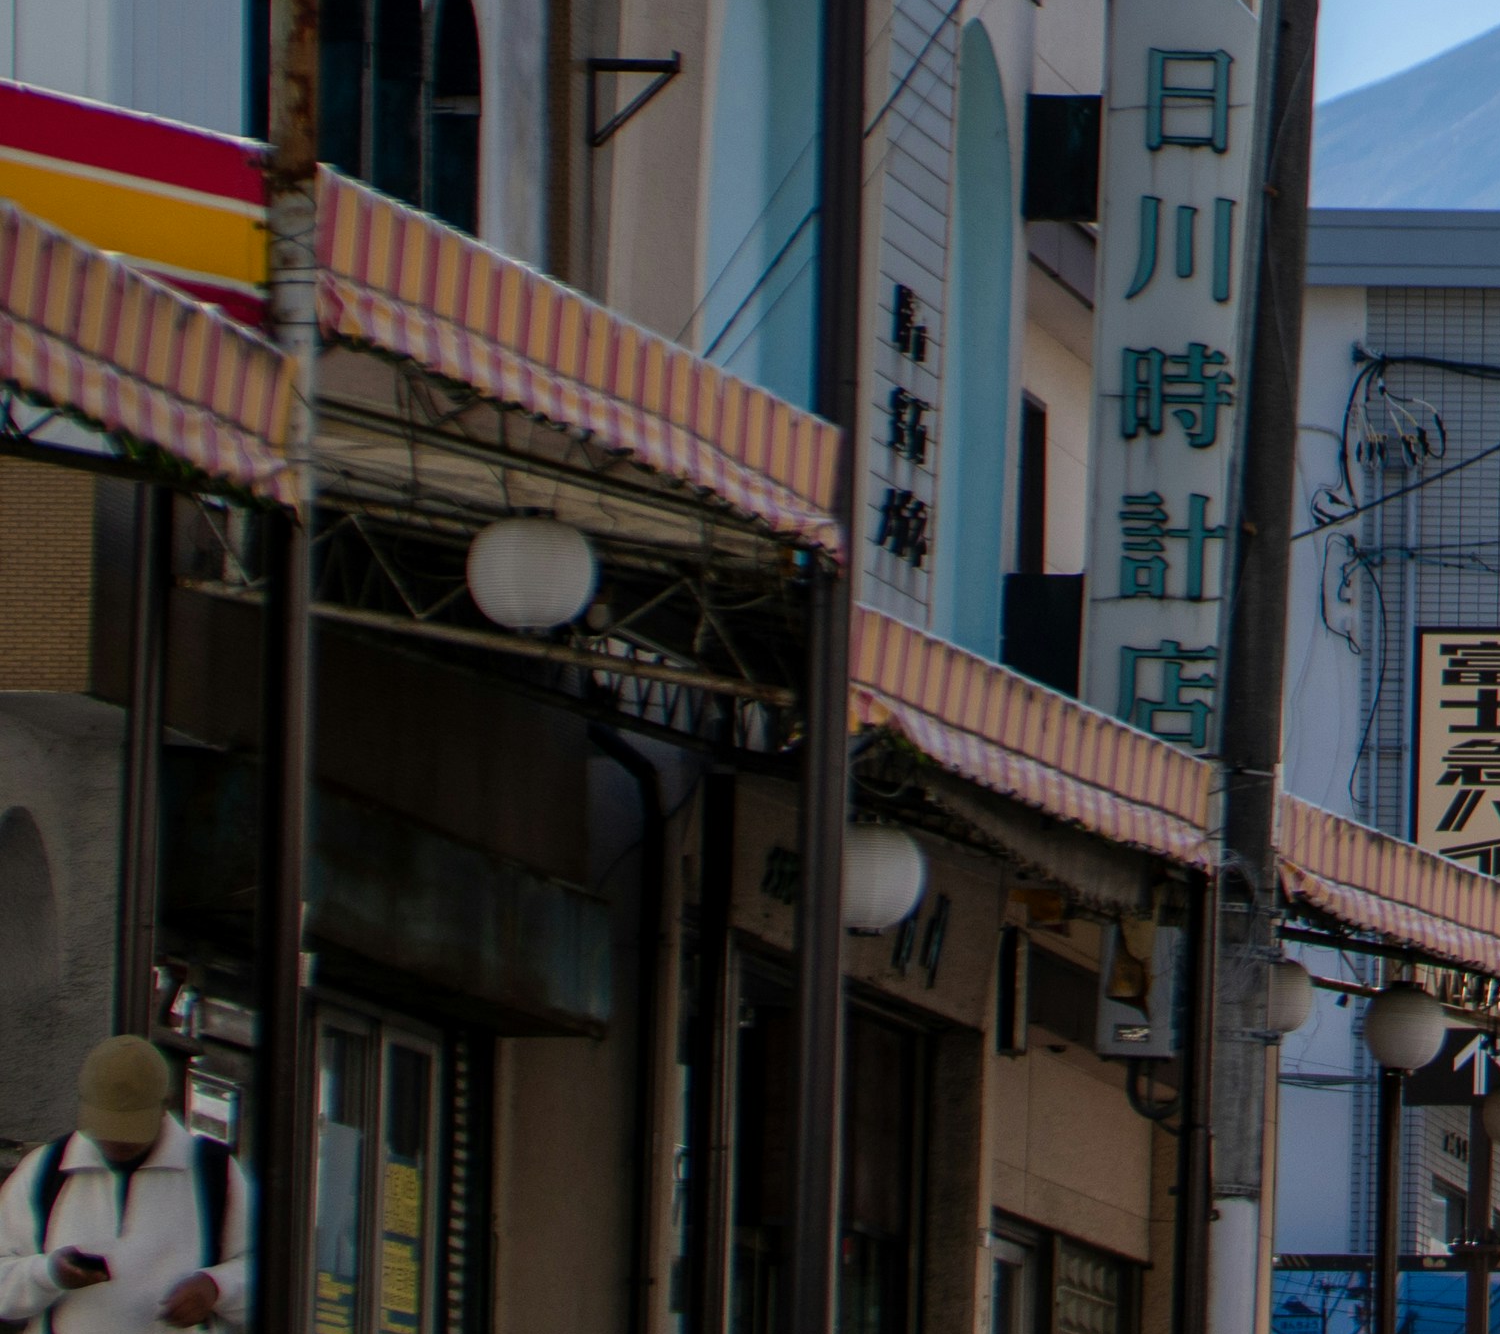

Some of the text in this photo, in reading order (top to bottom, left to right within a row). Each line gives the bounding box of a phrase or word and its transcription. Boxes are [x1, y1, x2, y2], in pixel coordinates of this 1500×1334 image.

[1117, 45, 1234, 750] 日川時計店
